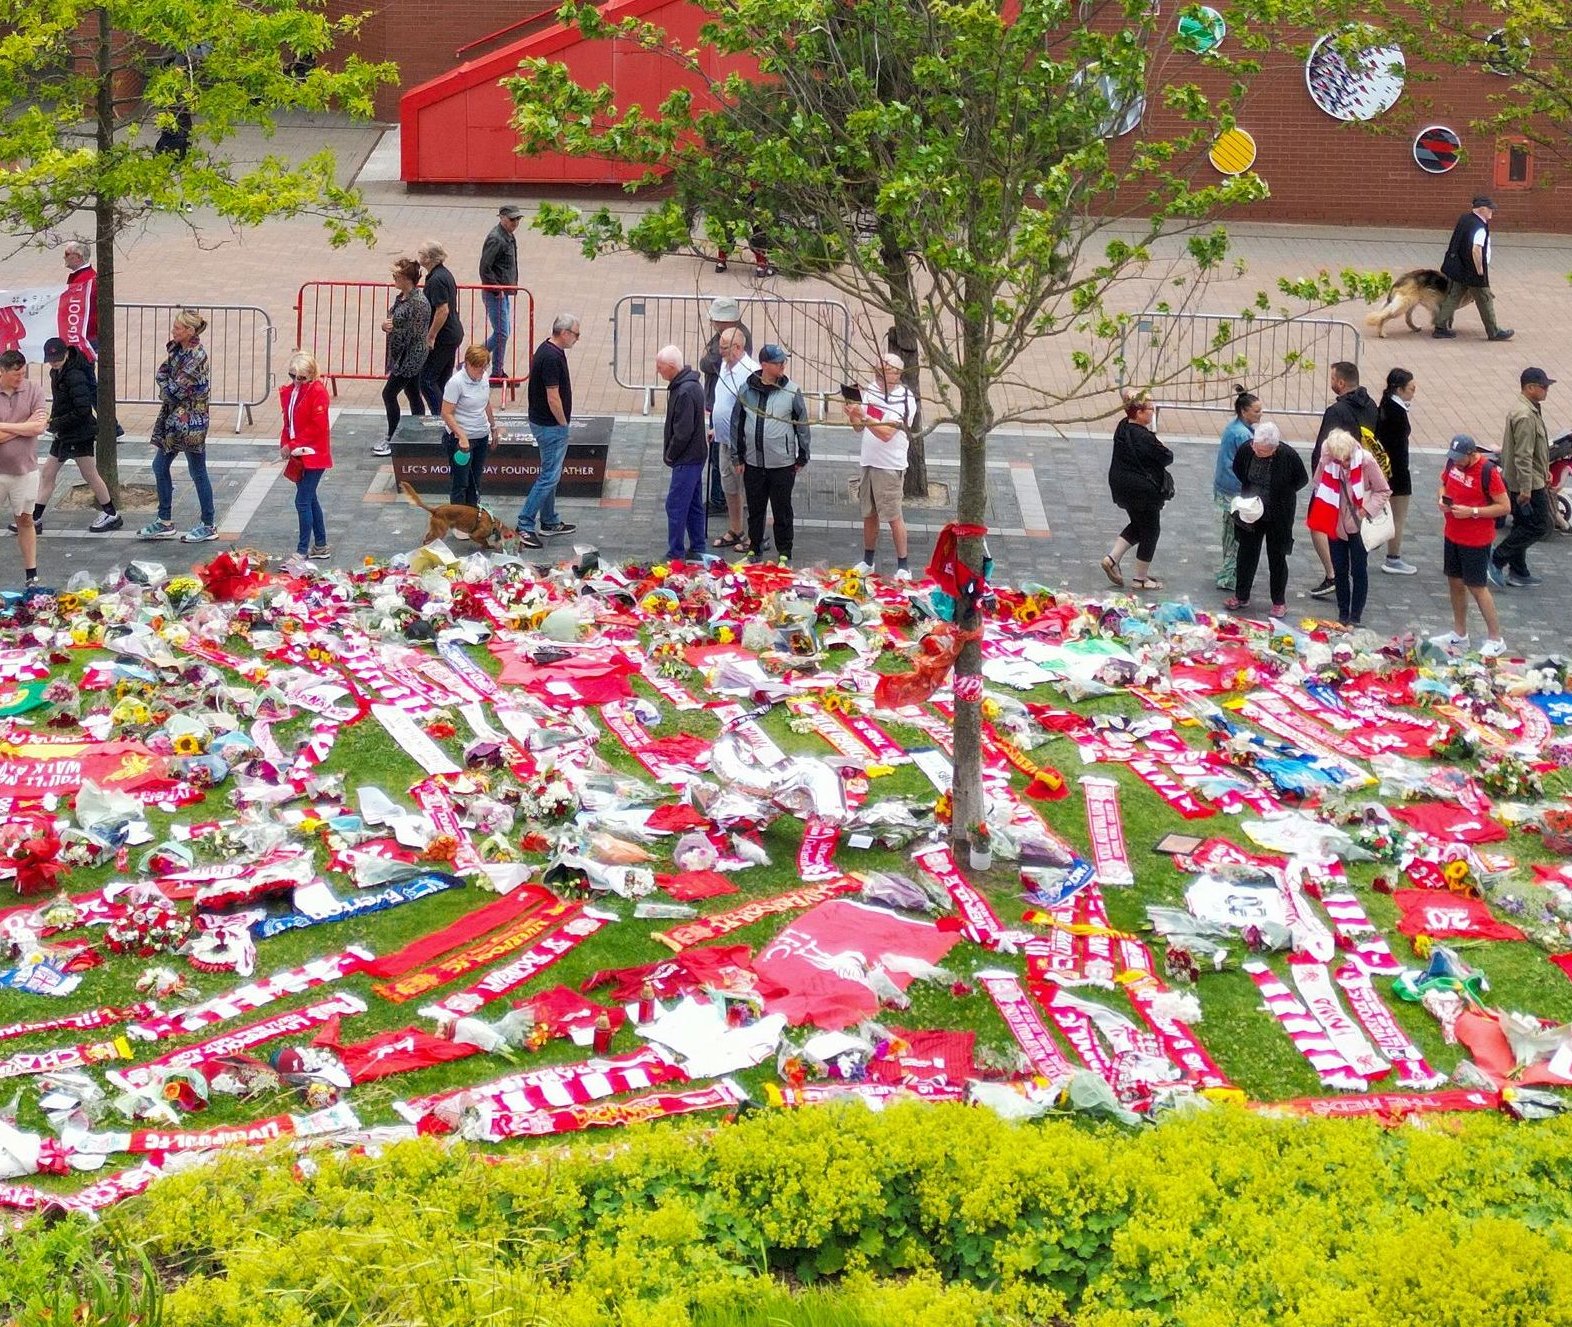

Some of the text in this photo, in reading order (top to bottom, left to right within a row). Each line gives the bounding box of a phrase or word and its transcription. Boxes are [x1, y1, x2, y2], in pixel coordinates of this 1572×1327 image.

[402, 464, 427, 475] LFC'S
[501, 465, 543, 476] FOUNDI
[563, 466, 594, 476] ATHER
[144, 1133, 171, 1150] FC
